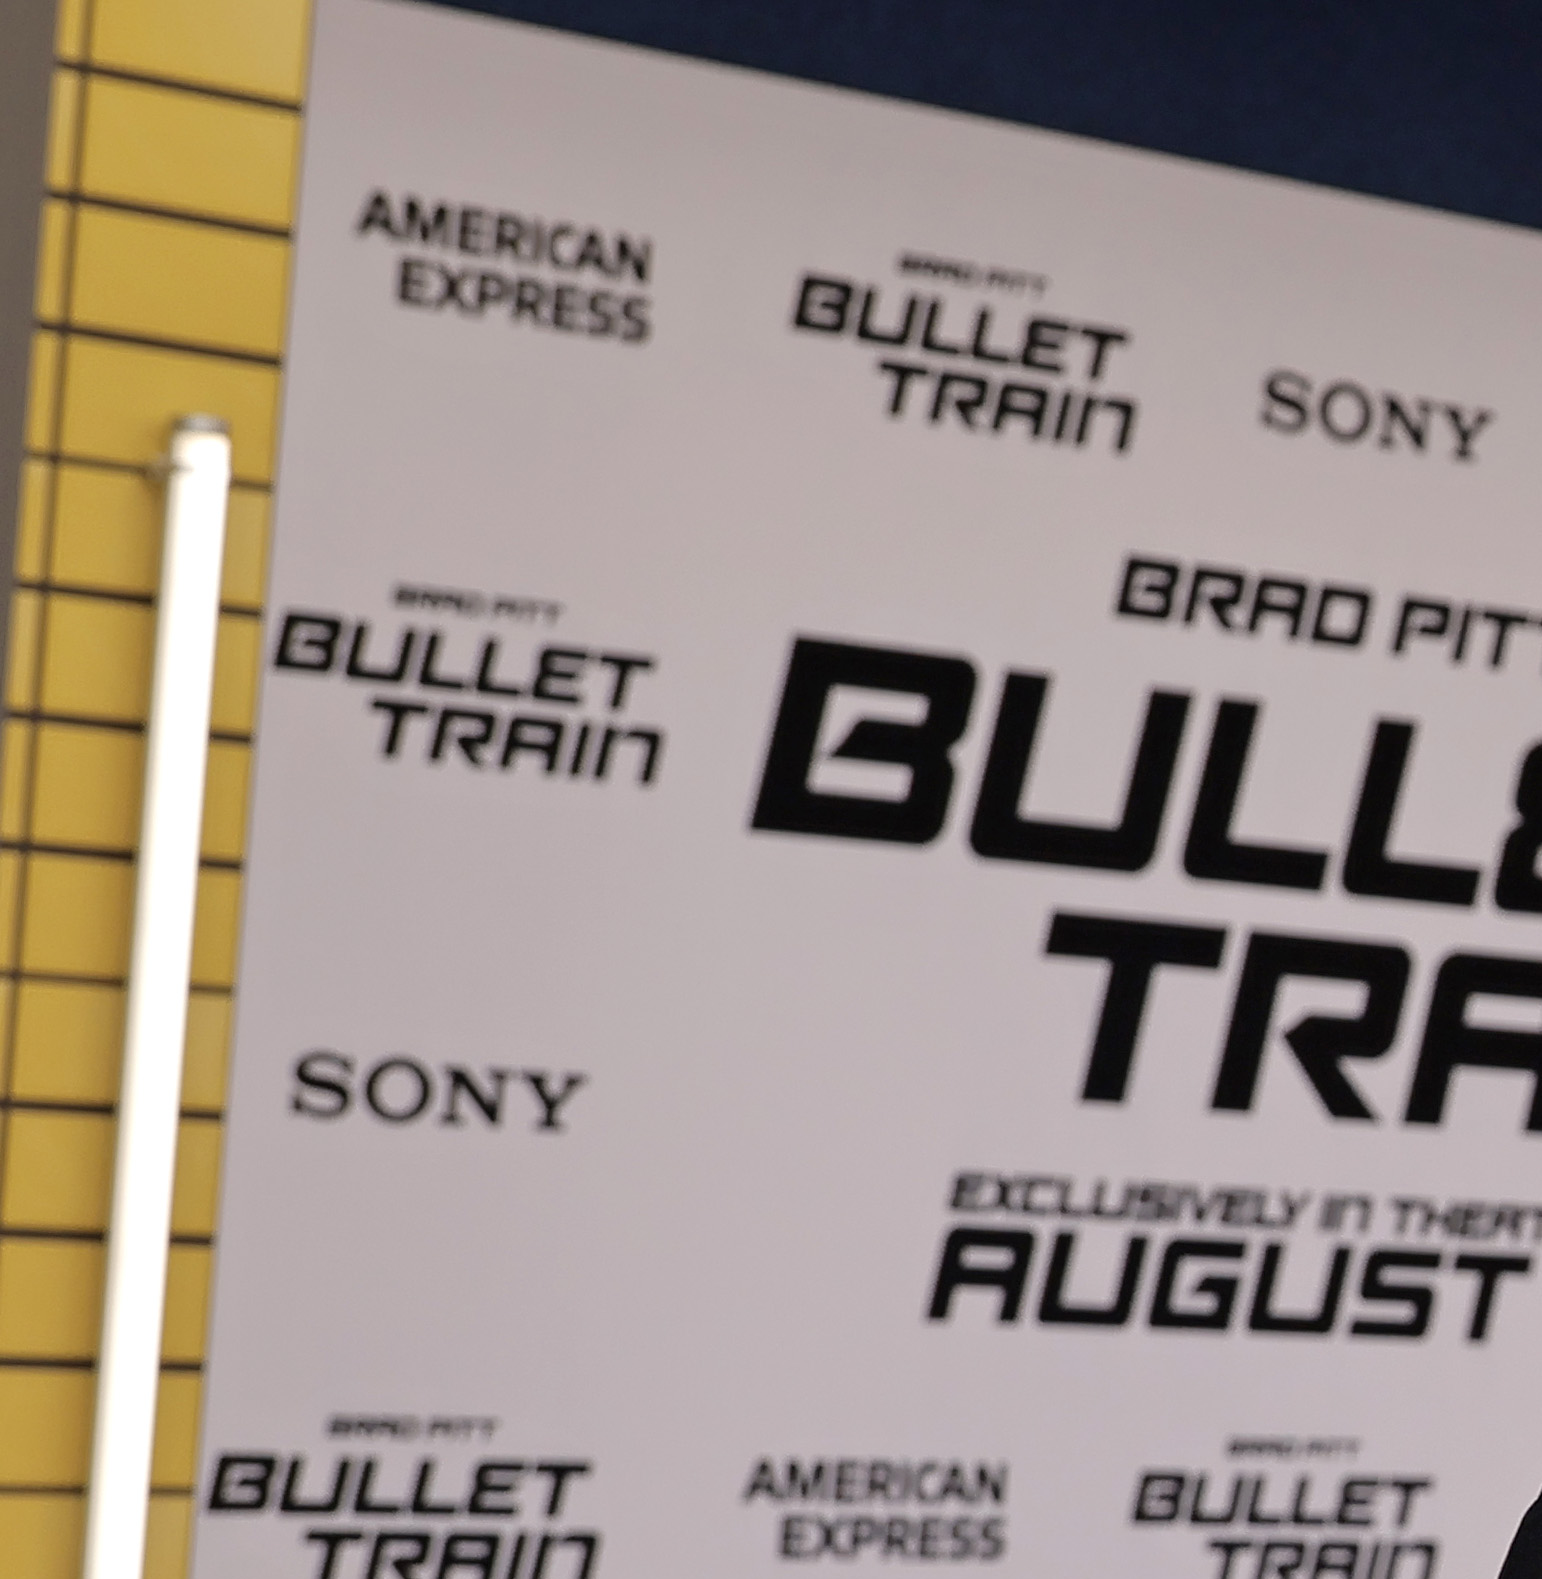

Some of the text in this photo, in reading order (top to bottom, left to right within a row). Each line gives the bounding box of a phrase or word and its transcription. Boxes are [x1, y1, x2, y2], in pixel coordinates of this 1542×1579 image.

[357, 191, 651, 283] AMERICAN
[396, 256, 650, 344] EXPRESS
[791, 273, 1128, 379] BULLET
[878, 359, 1136, 454] TRAIN
[1261, 371, 1491, 462] SONY
[1114, 555, 1374, 649] BRAD
[272, 611, 655, 712] BULLET
[370, 697, 663, 786] TRAIN
[290, 1051, 583, 1131] SONY
[926, 1227, 1534, 1344] AUGUST
[206, 1452, 591, 1520] BULLET
[743, 1458, 1007, 1505] AMERICAN
[1130, 1470, 1433, 1529] BULLET
[777, 1514, 1006, 1562] EXPRESS
